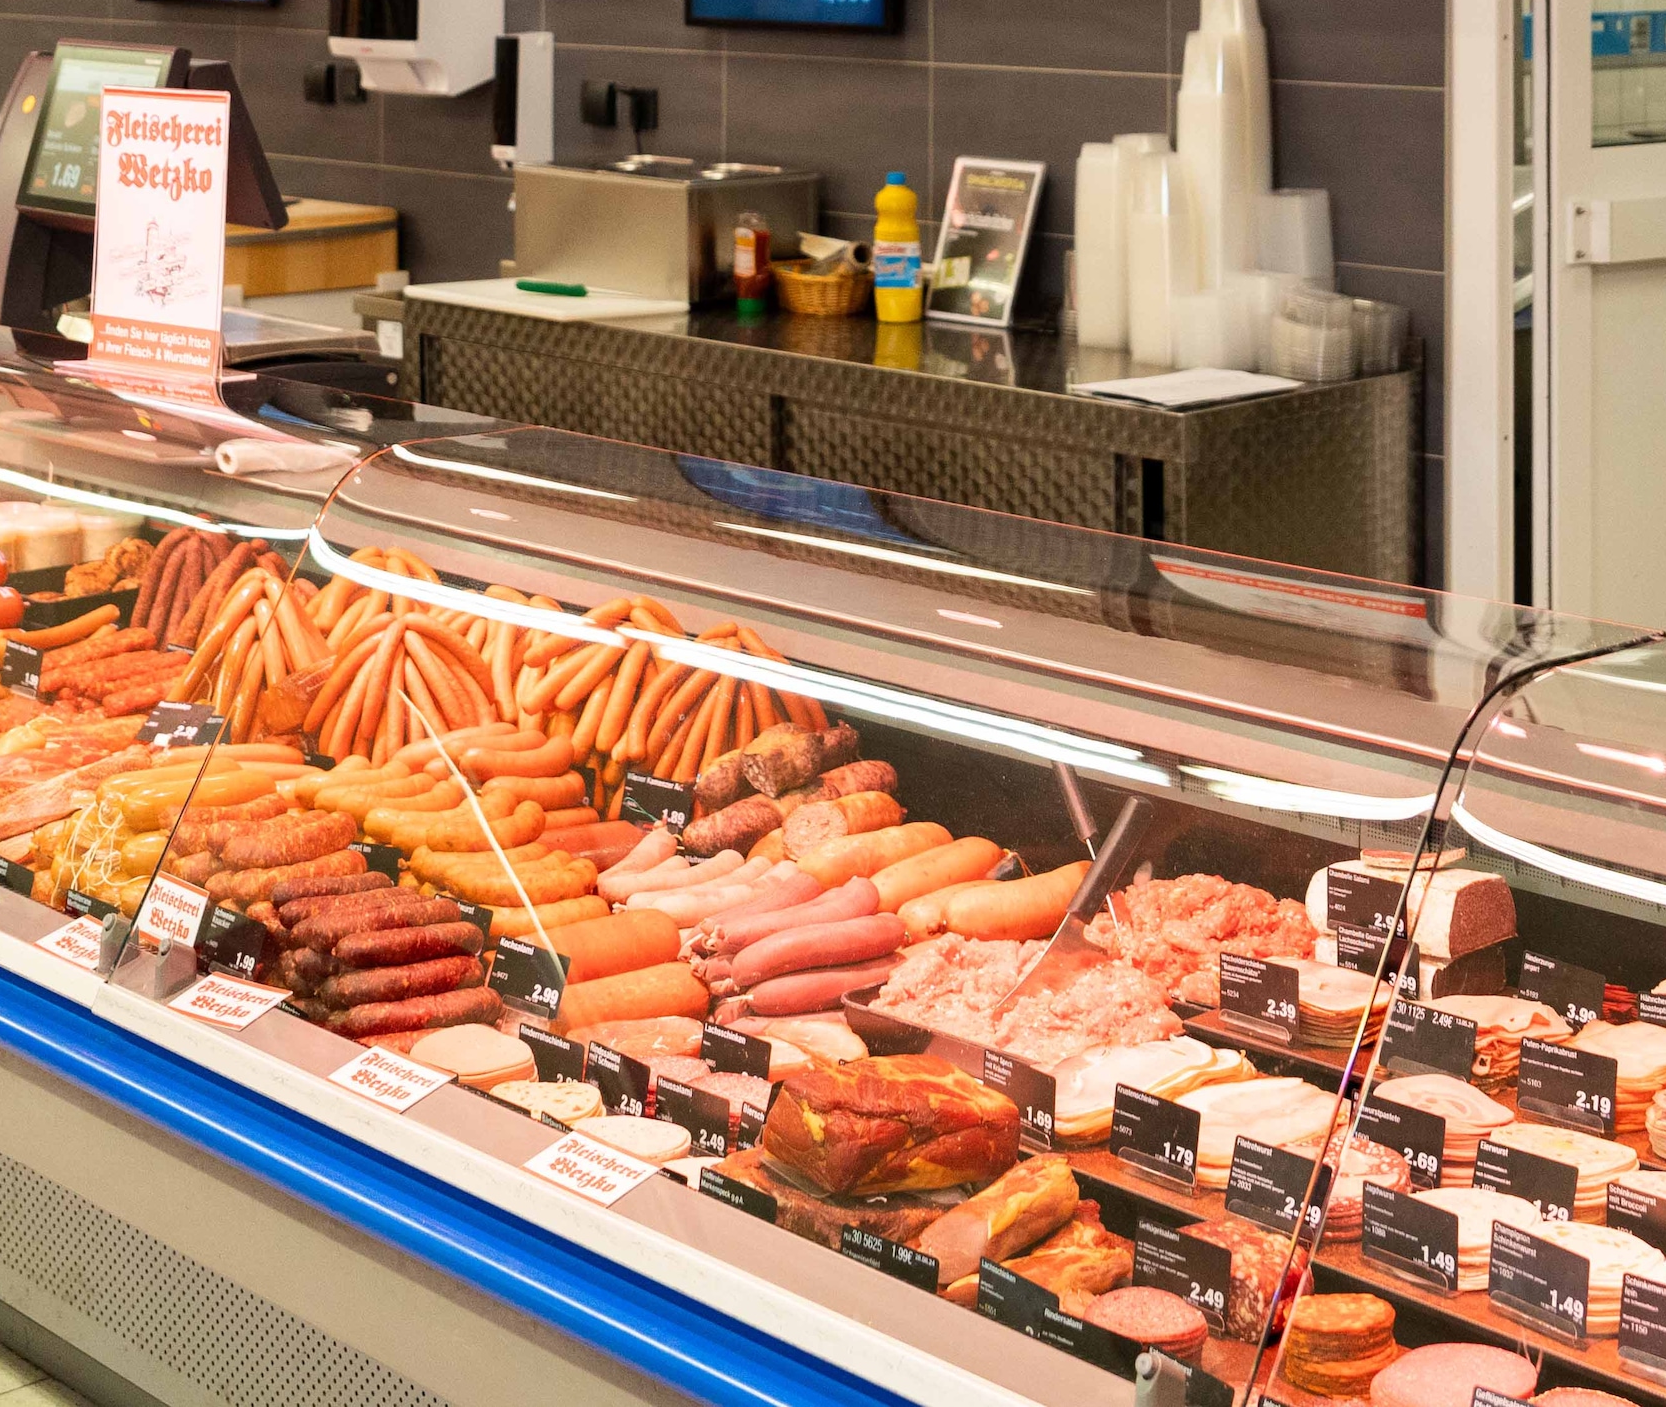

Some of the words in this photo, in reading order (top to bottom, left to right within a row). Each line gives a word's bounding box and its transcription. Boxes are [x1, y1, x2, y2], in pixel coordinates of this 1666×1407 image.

[106, 110, 222, 152] Fleischerei
[118, 152, 212, 201] Wetzko
[130, 326, 142, 340] Sie
[149, 882, 201, 919] Fleischerei
[148, 906, 190, 941] Wetzko
[500, 937, 534, 956] Kochsalami
[197, 980, 275, 1006] Fleischerei
[532, 984, 559, 1005] 2.99
[190, 995, 251, 1020] Wetzko
[1267, 998, 1297, 1019] 2.39
[1408, 1004, 1425, 1020] 1125
[1432, 1012, 1453, 1029] 2.49€
[704, 1022, 746, 1045] Lachsschinken
[1522, 1038, 1578, 1059] Puten-Paprikabrust
[359, 1051, 440, 1089] Fleischerei
[349, 1067, 411, 1102] Wetzko
[658, 1079, 693, 1097] Haussalami
[1117, 1085, 1159, 1107] Krustenschinken
[620, 1094, 642, 1117] 2.59
[1575, 1090, 1611, 1113] 2.19
[1026, 1105, 1052, 1130] 1.69
[699, 1128, 725, 1151] 2.49
[1237, 1137, 1273, 1157] Filetrotwurst
[1480, 1141, 1509, 1157] Eierwurst
[557, 1138, 647, 1182] Fleischerei
[1163, 1141, 1194, 1167] 1.79
[1403, 1147, 1437, 1173] 2.69
[548, 1156, 617, 1194] Wetzko
[1364, 1184, 1395, 1202] Jagdwurst
[1608, 1183, 1657, 1207] Schinkenwurst
[1609, 1194, 1620, 1206] mit
[1621, 1197, 1647, 1213] Broccoli
[852, 1229, 862, 1244] 30
[863, 1233, 882, 1253] 5625
[1493, 1231, 1537, 1257] Schinkenwurst
[1494, 1222, 1531, 1244] Champignon
[1421, 1244, 1455, 1273] 1.49
[1190, 1281, 1224, 1309] 2.49
[1550, 1289, 1584, 1319] 1.49
[1624, 1287, 1638, 1298] fein
[1044, 1307, 1083, 1331] Rindersalami
